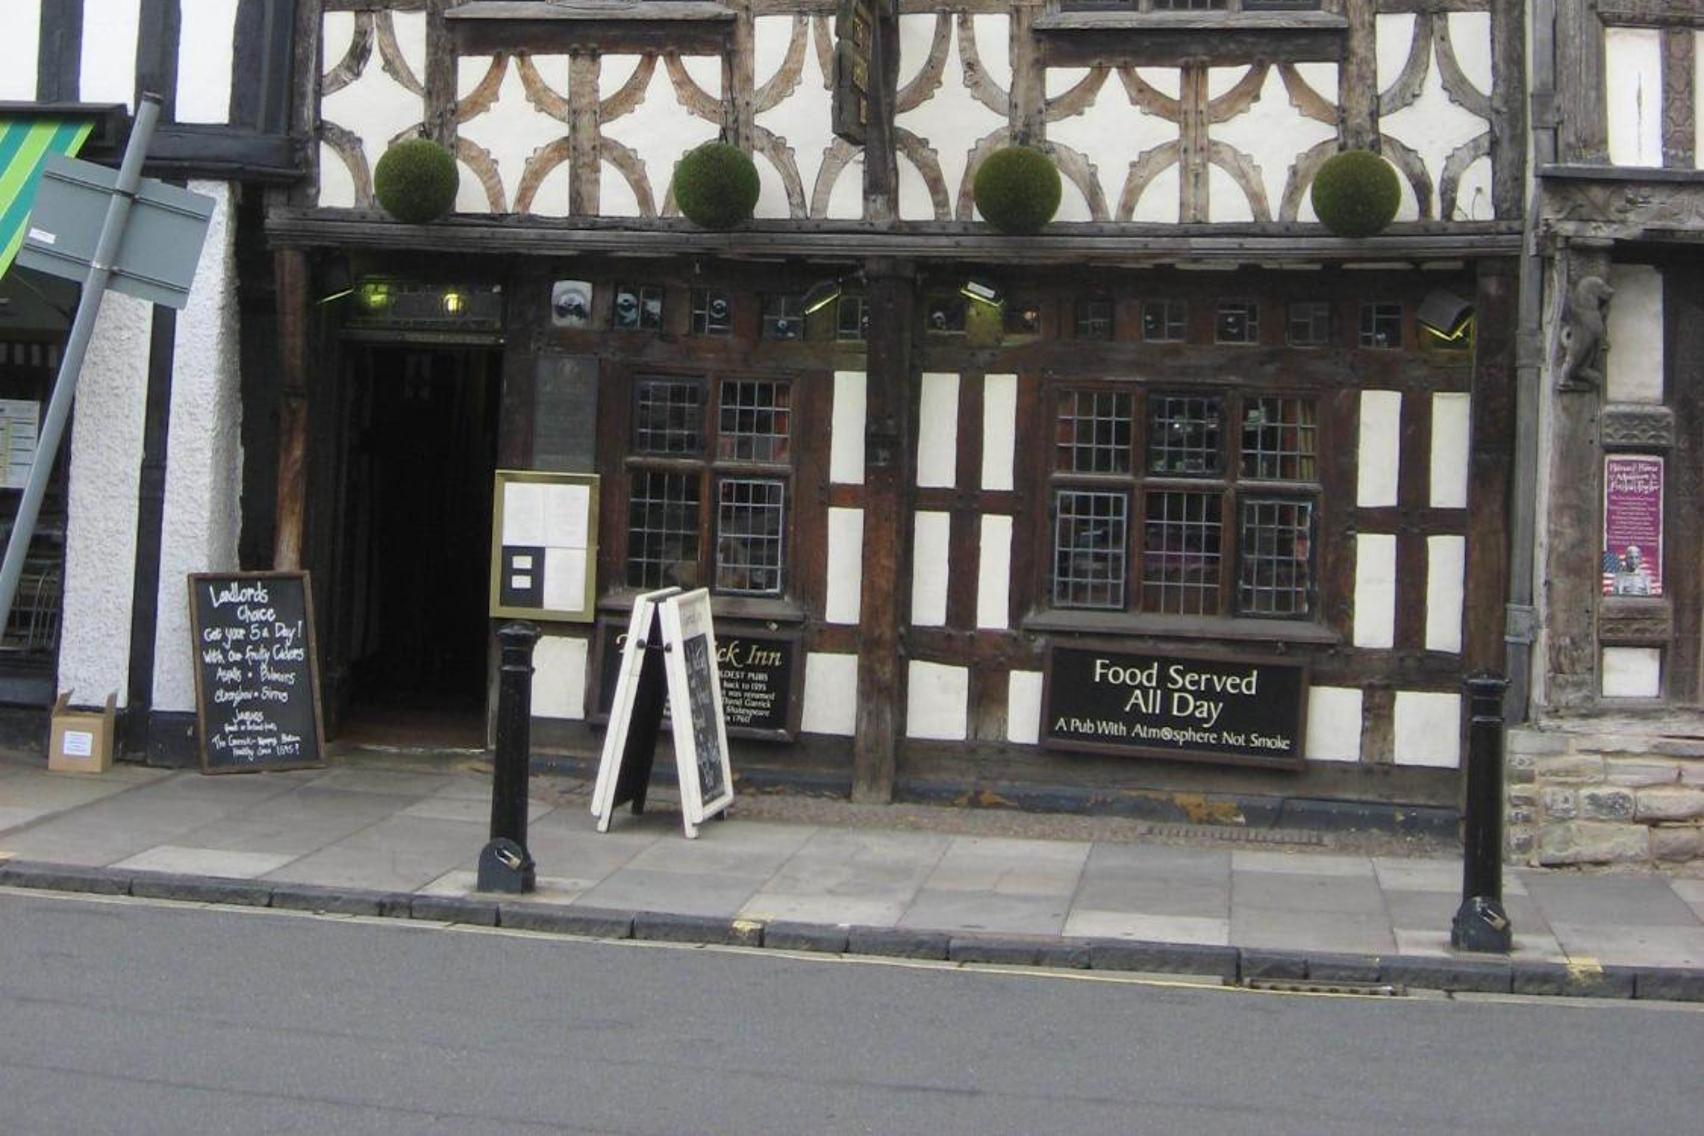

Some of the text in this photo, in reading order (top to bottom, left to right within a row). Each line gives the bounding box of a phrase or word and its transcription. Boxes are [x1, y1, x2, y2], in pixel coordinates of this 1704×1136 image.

[222, 627, 246, 650] your
[249, 623, 261, 640] 5
[745, 643, 783, 667] Inn
[742, 682, 750, 690] to
[747, 672, 769, 682] PUBS
[1094, 659, 1258, 695] Food Served
[743, 692, 776, 701] renamed
[744, 699, 771, 708] Garrick
[1124, 689, 1224, 728] All Day
[211, 733, 227, 750] The
[1055, 717, 1067, 732] A
[1070, 718, 1095, 734] Pub
[1097, 719, 1127, 737] With
[1221, 731, 1246, 747] Not
[1249, 733, 1291, 751] Smoke
